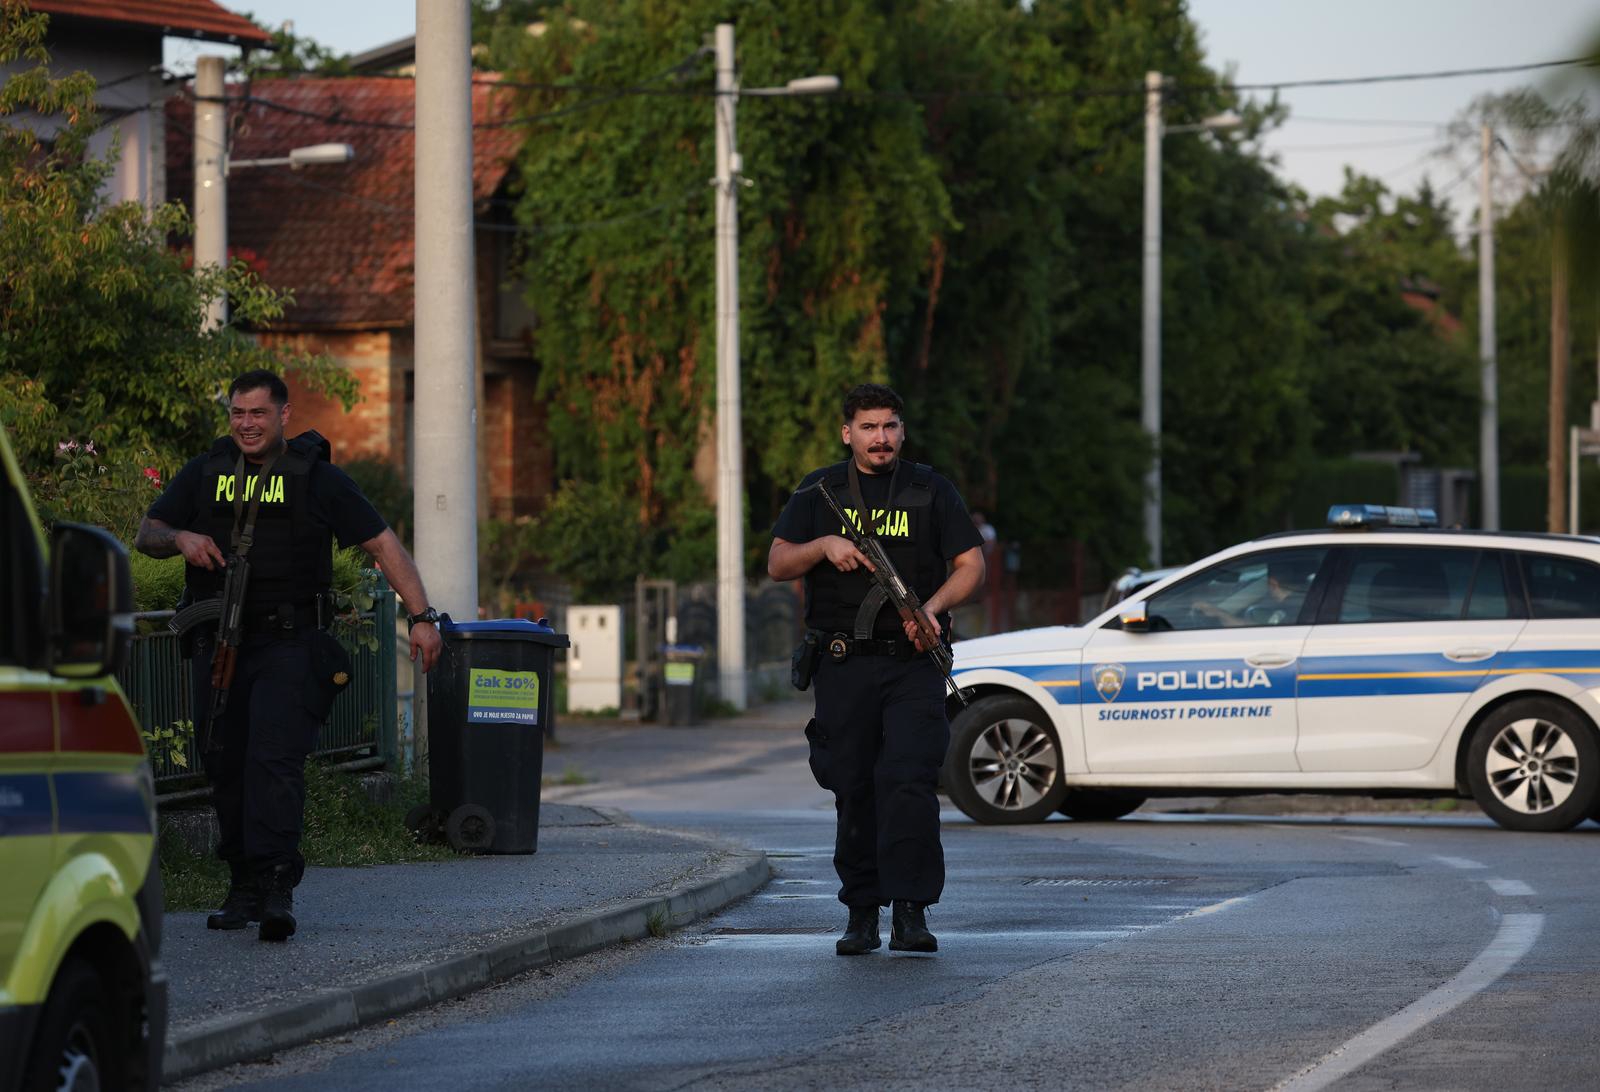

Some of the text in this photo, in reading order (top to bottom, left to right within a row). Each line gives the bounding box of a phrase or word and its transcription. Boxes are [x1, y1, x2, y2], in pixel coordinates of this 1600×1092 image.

[475, 674, 536, 690] čak 30%
[1136, 668, 1272, 691] POLICIJA
[488, 711, 500, 719] MOJE
[1098, 707, 1176, 721] SIGURNOST
[1179, 707, 1186, 720] I
